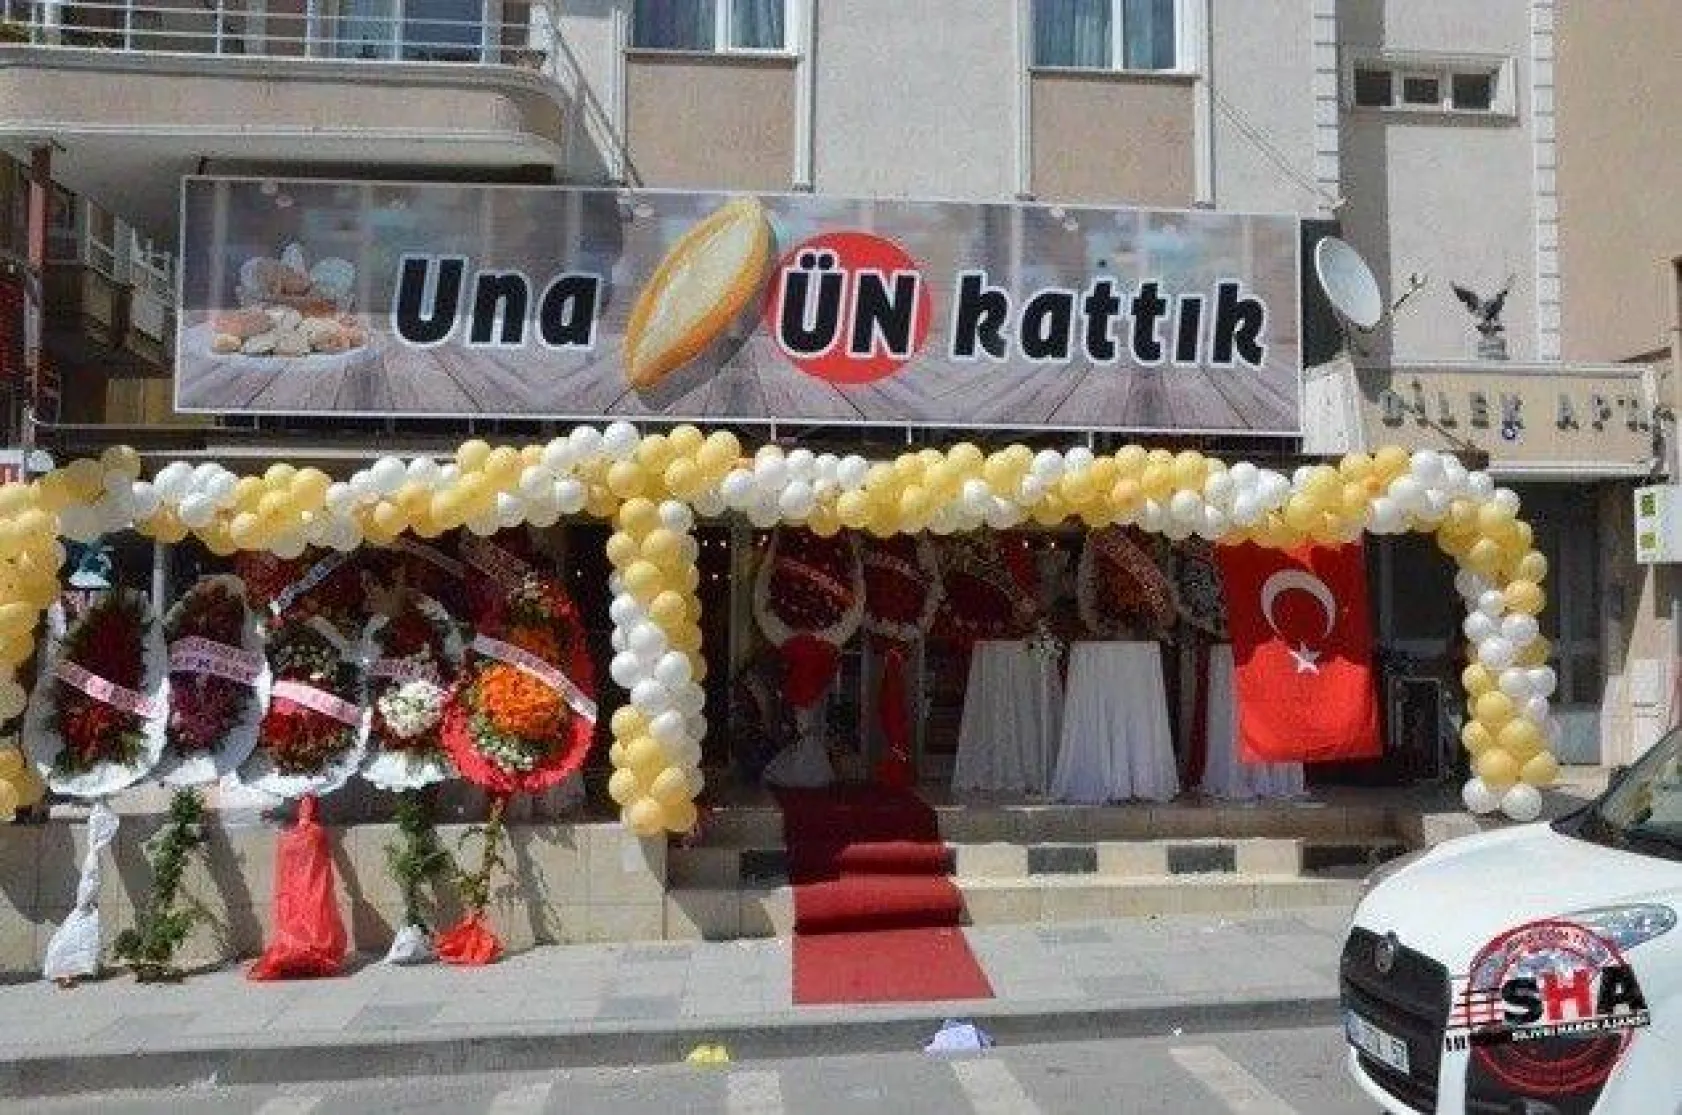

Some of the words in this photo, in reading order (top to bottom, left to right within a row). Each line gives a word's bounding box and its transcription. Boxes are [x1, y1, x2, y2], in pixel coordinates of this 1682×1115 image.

[395, 257, 599, 346] Una
[779, 251, 919, 357] ÜN
[952, 271, 1265, 366] kattık
